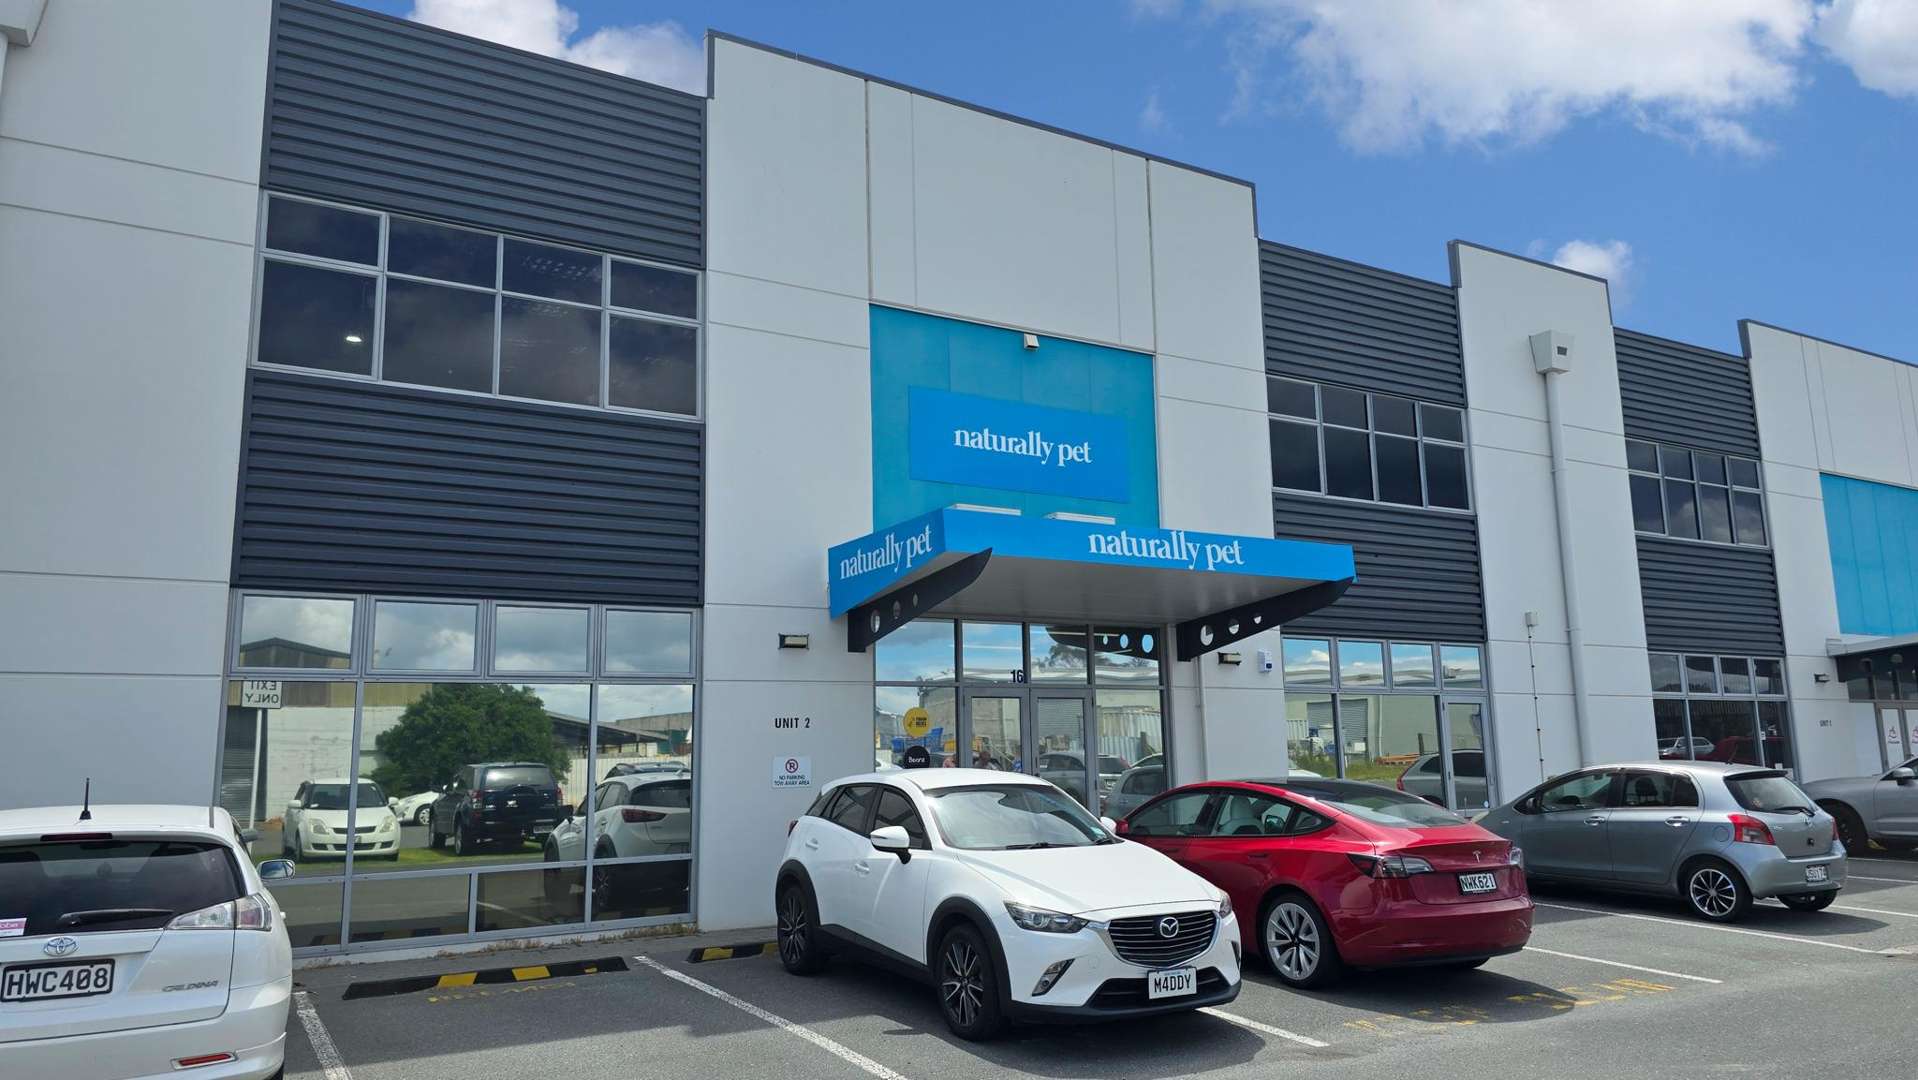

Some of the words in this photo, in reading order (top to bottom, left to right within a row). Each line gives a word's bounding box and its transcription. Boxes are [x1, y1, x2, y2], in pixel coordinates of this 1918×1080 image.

[953, 427, 1055, 465] naturally
[1057, 441, 1093, 467] pet
[840, 531, 904, 580] naturally
[905, 524, 933, 569] pet
[1088, 529, 1201, 570] naturally
[1204, 539, 1245, 571] pet
[1010, 669, 1024, 683] 16
[774, 717, 800, 729] UNIT
[804, 717, 811, 729] 2
[6, 967, 108, 996] HWC408
[1154, 974, 1191, 993] M4DDY
